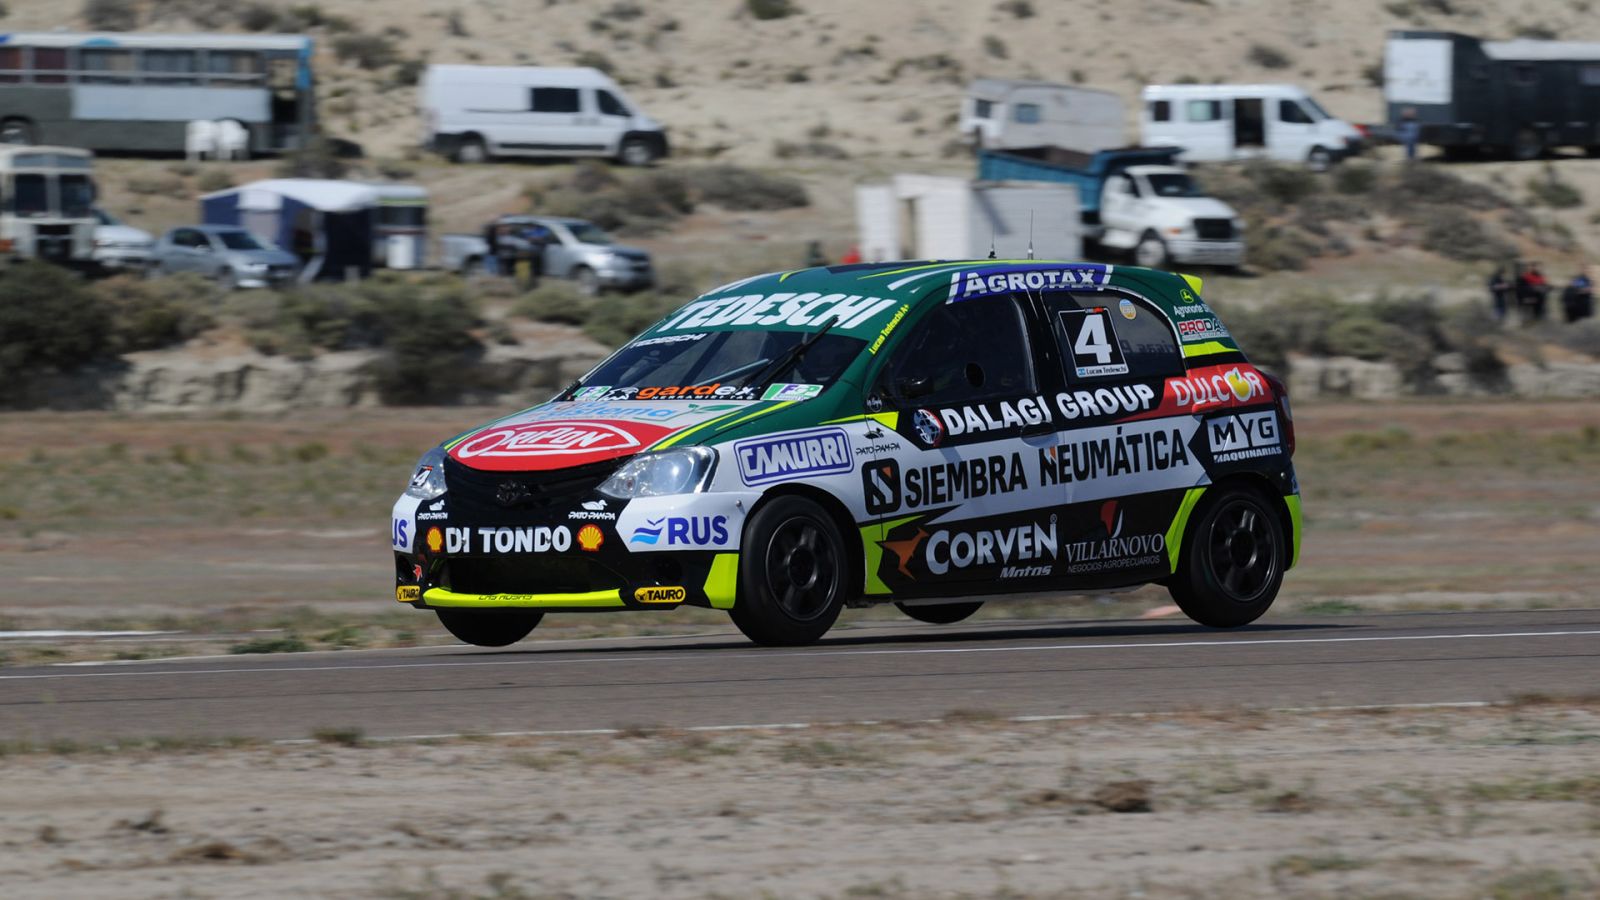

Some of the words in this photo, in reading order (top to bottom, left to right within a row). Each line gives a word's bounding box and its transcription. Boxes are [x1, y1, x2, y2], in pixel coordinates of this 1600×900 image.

[963, 269, 1095, 297] AGROTAX
[656, 292, 897, 332] TEDESCHI
[869, 335, 885, 354] Lucas
[881, 311, 904, 336] Tedeschi
[1074, 313, 1113, 364] 4
[1086, 367, 1102, 375] Lucas
[1103, 366, 1127, 374] Tedeschi
[636, 383, 755, 399] gardex
[1170, 367, 1264, 406] DULCOR
[940, 396, 1052, 436] DALAGI
[1056, 384, 1154, 420] GROUP
[458, 427, 615, 458] ORIPON
[1213, 415, 1275, 448] MYG
[740, 435, 848, 478] CAMURRI
[905, 452, 1028, 509] SIEMBRA
[1039, 426, 1189, 487] NEUMÁTICA
[1213, 446, 1282, 463] MAQUINARIAS
[414, 471, 429, 487] 4
[445, 526, 470, 553] DI
[478, 525, 572, 553] TONDO
[668, 515, 729, 545] RUS
[926, 521, 1058, 575] CORVEN
[1065, 532, 1164, 562] VILLARNOVO
[1067, 561, 1102, 573] NEGOCIOS
[1103, 555, 1160, 569] AGROPECUARIOS
[646, 589, 684, 601] TAURO
